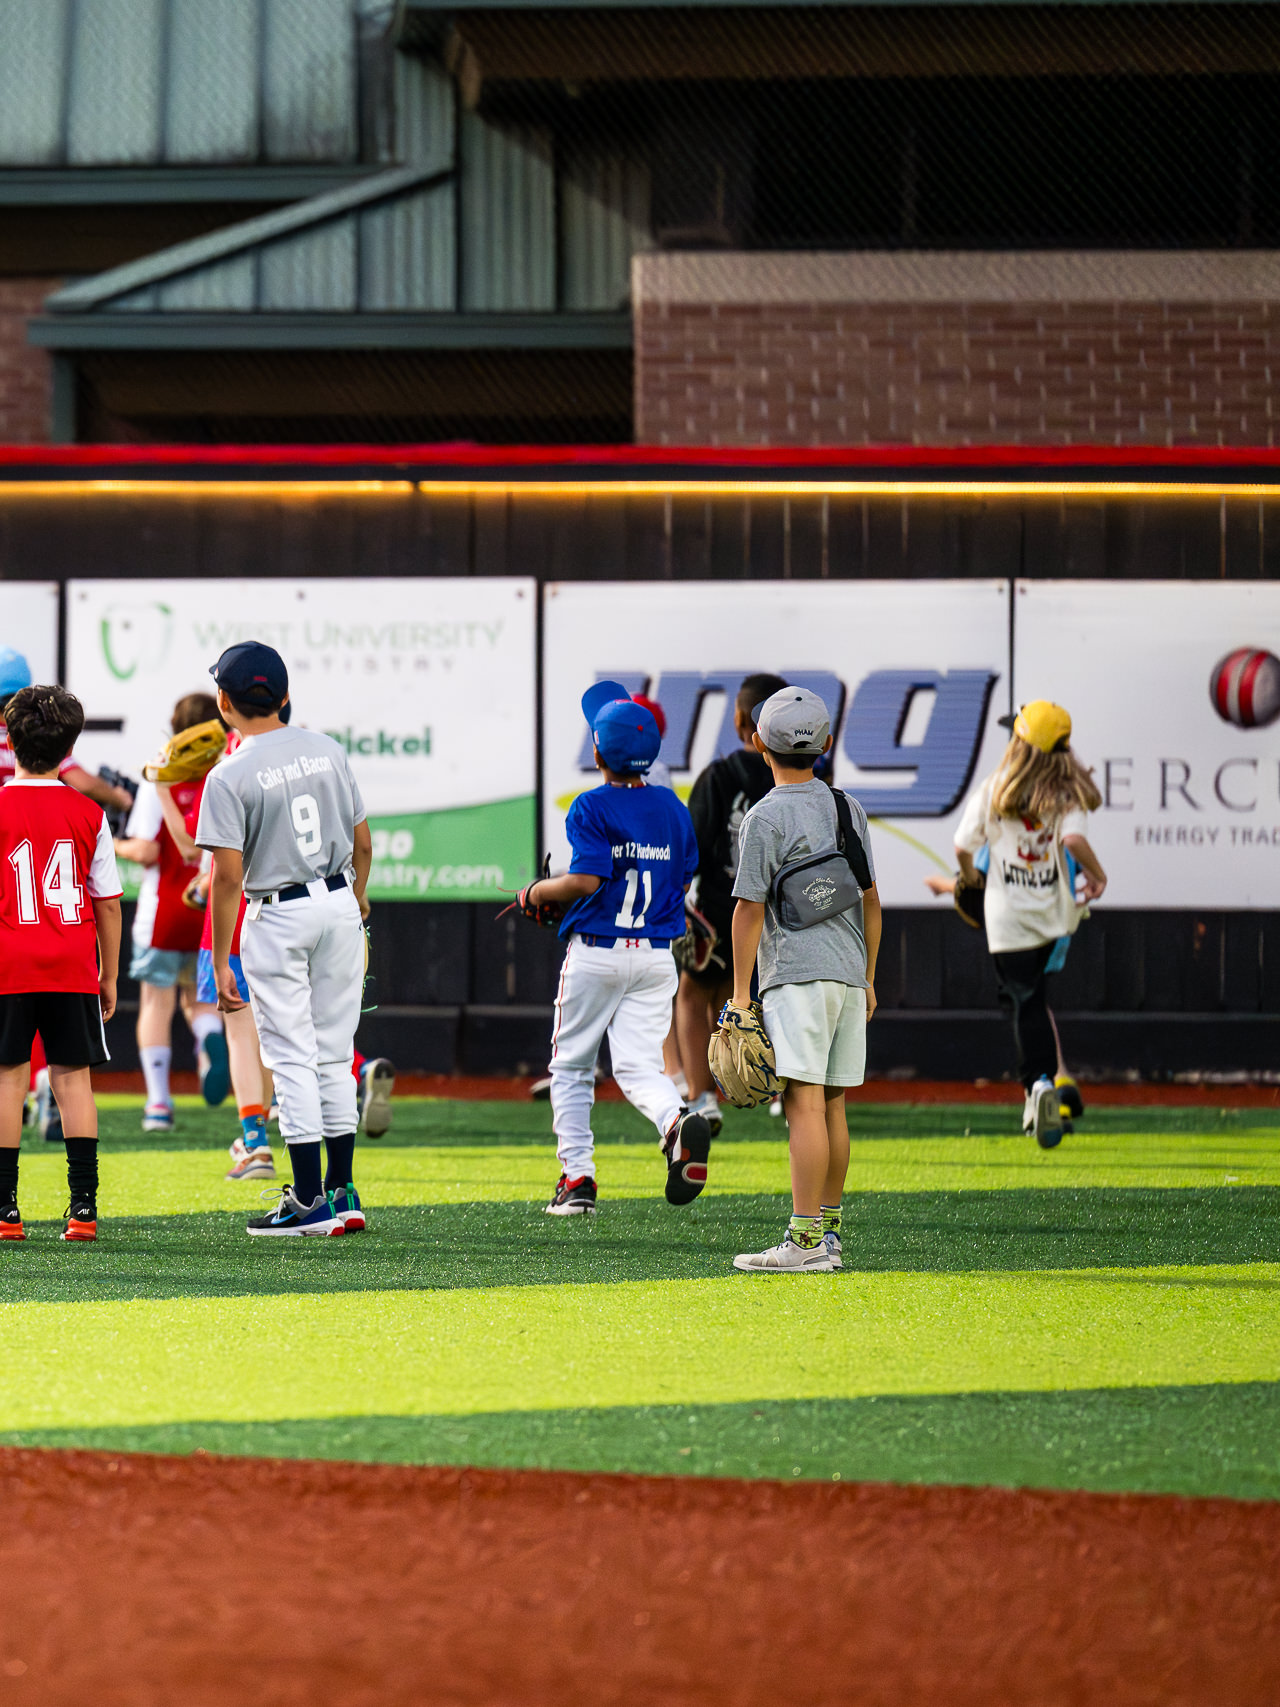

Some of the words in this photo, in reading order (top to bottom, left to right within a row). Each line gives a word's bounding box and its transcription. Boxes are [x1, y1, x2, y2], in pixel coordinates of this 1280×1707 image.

[192, 619, 293, 651] WEST
[304, 616, 507, 652] UNIVERSITY
[794, 728, 815, 737] PHAM
[256, 766, 284, 791] Cake
[284, 759, 300, 780] and
[300, 756, 333, 777] Bacon
[1102, 757, 1280, 812] ERC
[291, 794, 322, 857] 9
[1134, 824, 1219, 846] ENERGY
[626, 842, 636, 858] 12
[8, 838, 84, 925] 14
[615, 868, 652, 929] 11
